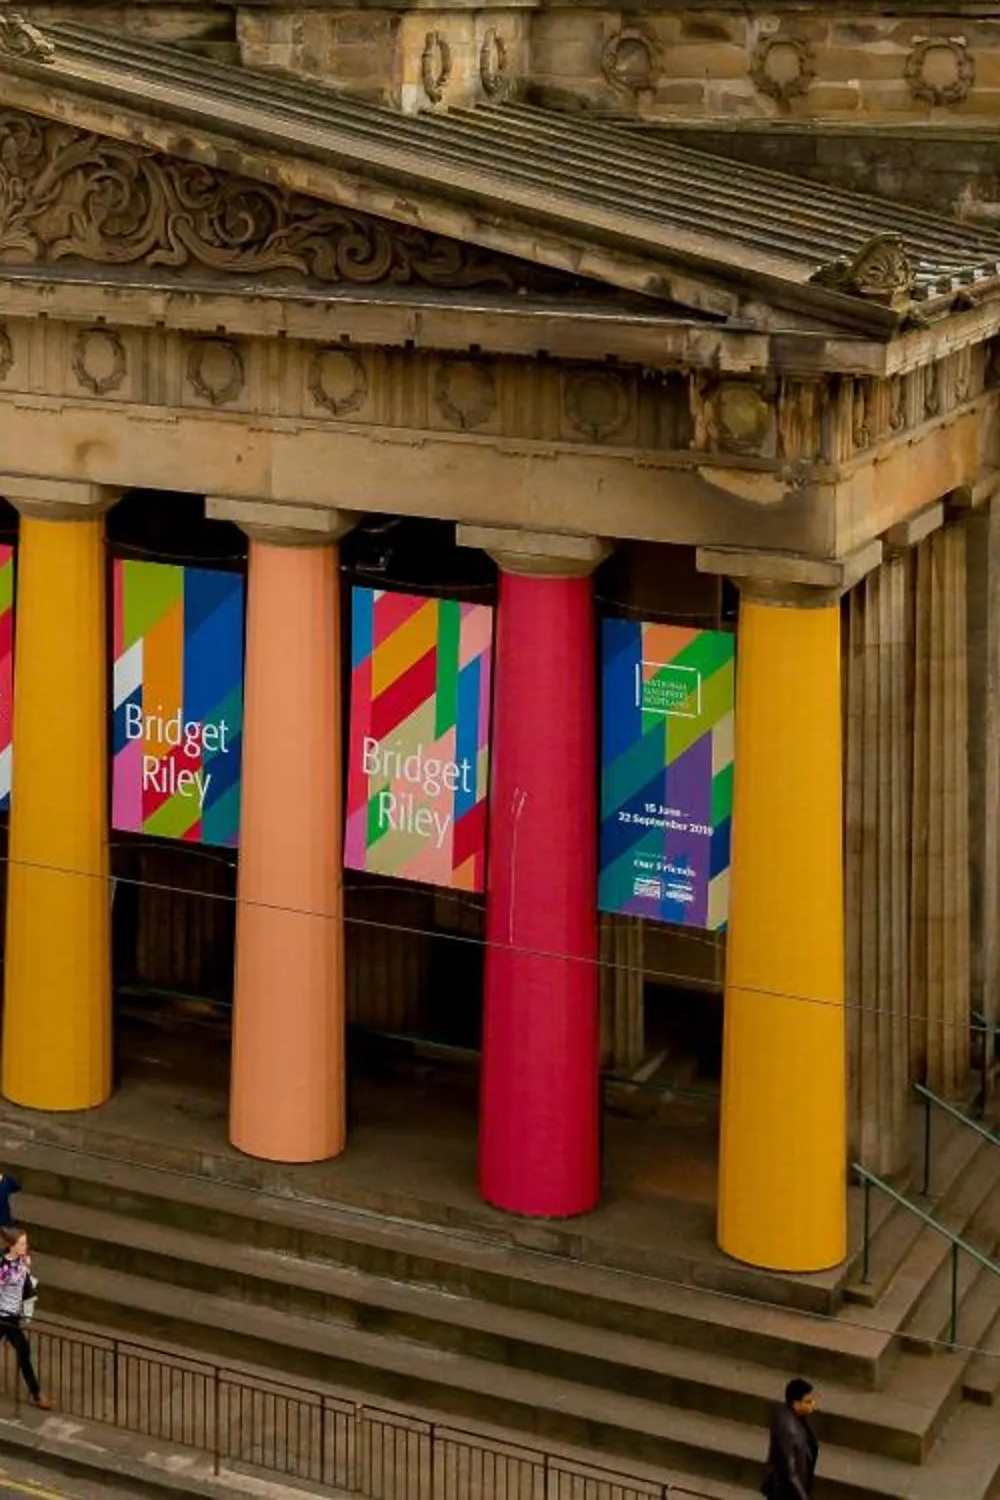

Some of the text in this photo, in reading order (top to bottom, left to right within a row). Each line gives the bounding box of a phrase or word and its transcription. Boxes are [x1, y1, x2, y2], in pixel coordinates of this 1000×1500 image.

[124, 703, 230, 757] Bridget
[142, 755, 211, 808] Riley
[362, 737, 472, 796] Bridget
[379, 791, 453, 848] Riley
[632, 813, 687, 831] September
